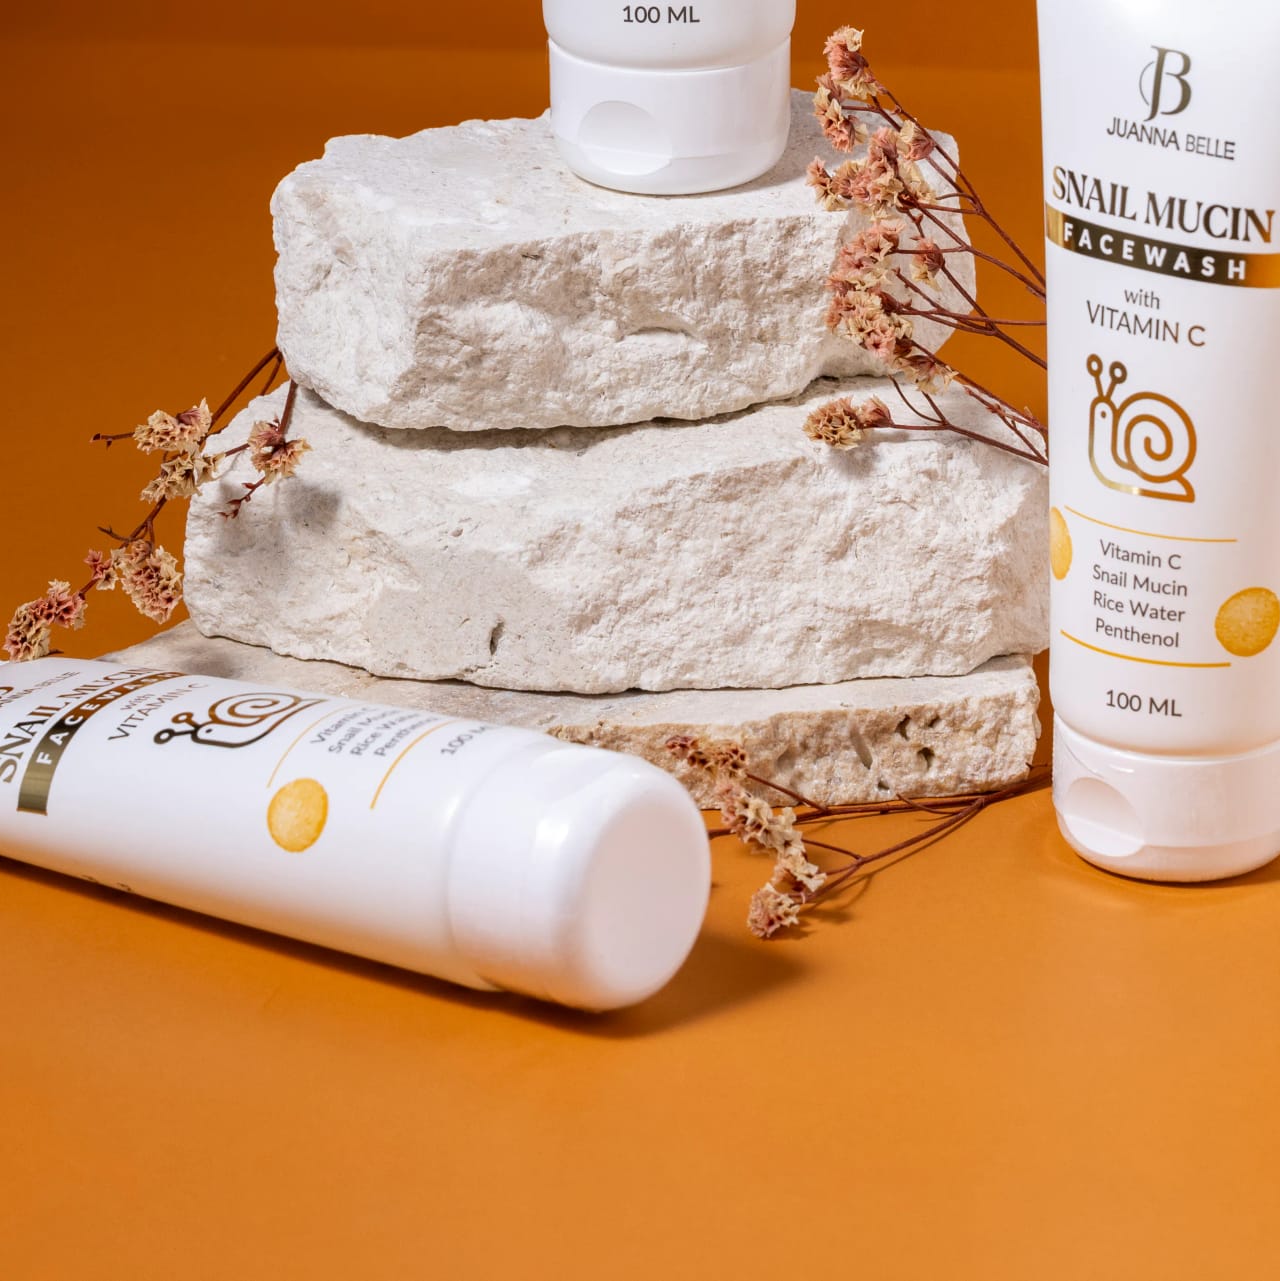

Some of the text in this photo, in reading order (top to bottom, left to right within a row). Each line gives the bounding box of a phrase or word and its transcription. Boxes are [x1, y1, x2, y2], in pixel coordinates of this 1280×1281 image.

[622, 4, 701, 24] 100 ML
[1107, 117, 1237, 161] JUANNA BELLE
[1051, 165, 1276, 244] SNAIL MUCIN
[1062, 222, 1247, 281] FACEWASH
[1123, 288, 1161, 311] with
[1086, 300, 1206, 348] VITAMIN C
[1099, 539, 1182, 571] Vitamin C
[1092, 564, 1188, 598] Snail Mucin
[1092, 591, 1187, 623] Rice Water
[1094, 618, 1181, 649] Penthenol
[107, 688, 192, 741] VITAMIN
[1106, 689, 1183, 718] 100 ML
[440, 733, 474, 755] 100
